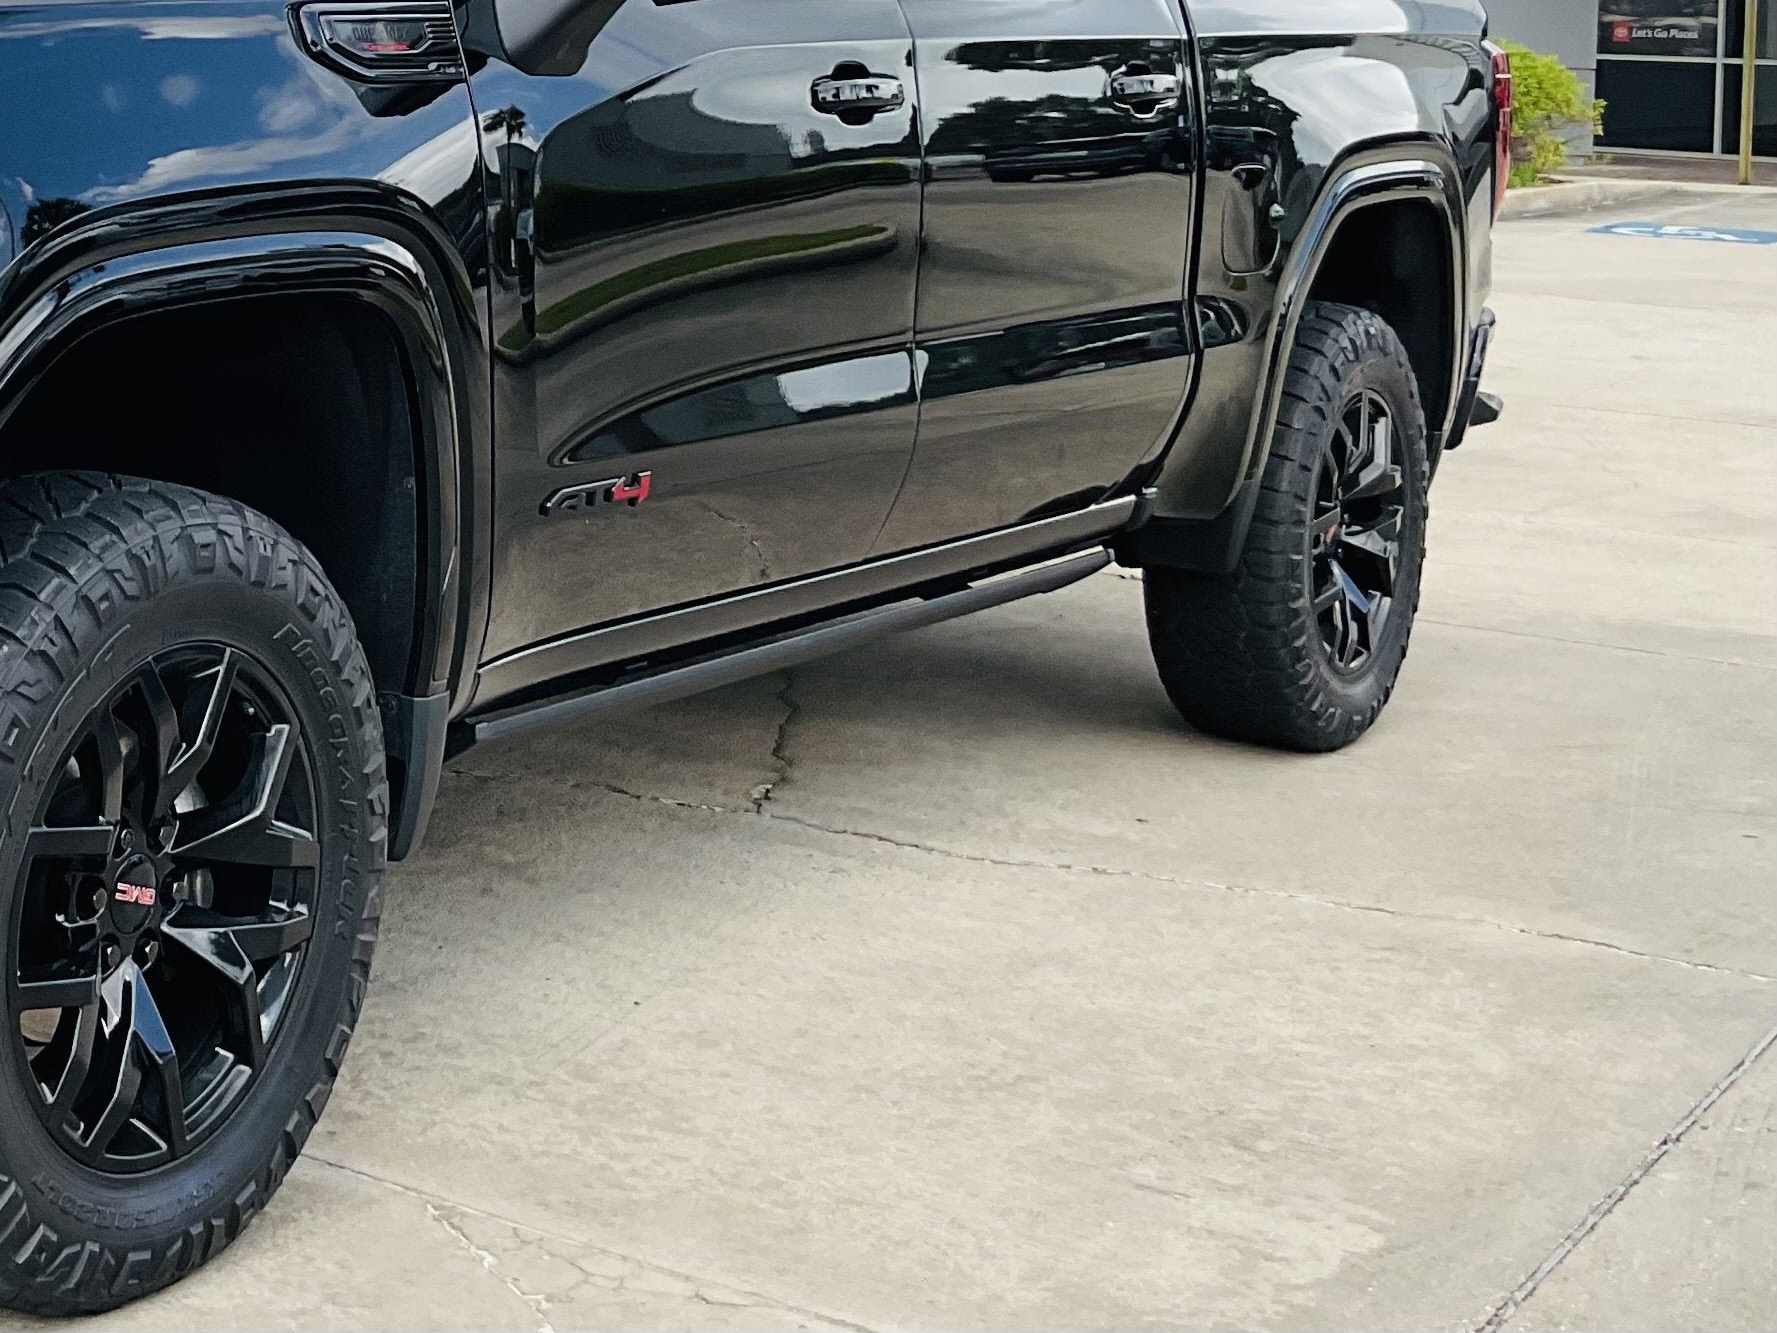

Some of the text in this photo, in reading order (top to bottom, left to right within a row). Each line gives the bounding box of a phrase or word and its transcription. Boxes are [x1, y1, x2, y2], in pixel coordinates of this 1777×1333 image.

[1632, 28, 1699, 39] Let's Go Places
[539, 469, 652, 517] AT4
[114, 882, 157, 905] GMC
